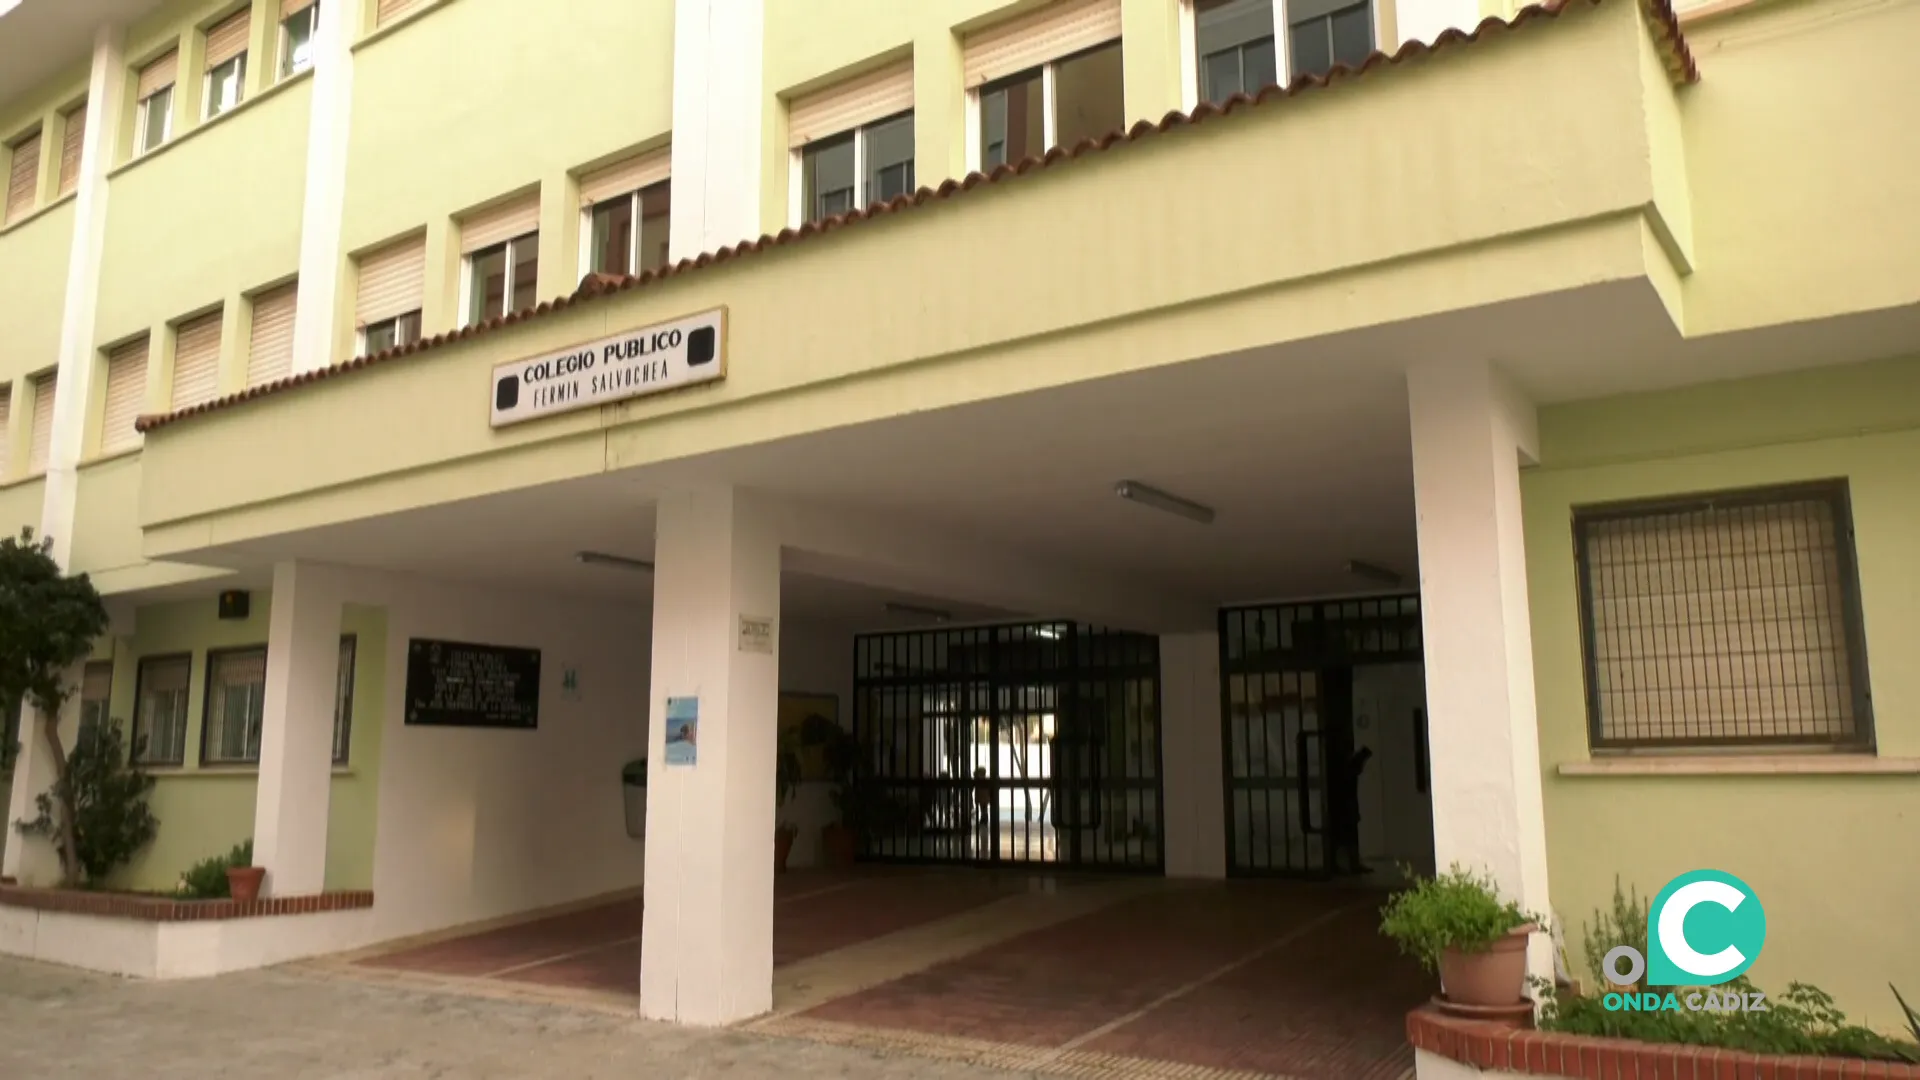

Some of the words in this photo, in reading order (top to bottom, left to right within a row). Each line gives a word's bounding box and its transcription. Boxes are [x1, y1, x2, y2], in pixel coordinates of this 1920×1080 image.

[523, 350, 595, 384] COLEGIO
[603, 328, 682, 364] PUBLICO
[533, 380, 580, 408] FERMIN
[591, 359, 668, 395] SALVOCHEA
